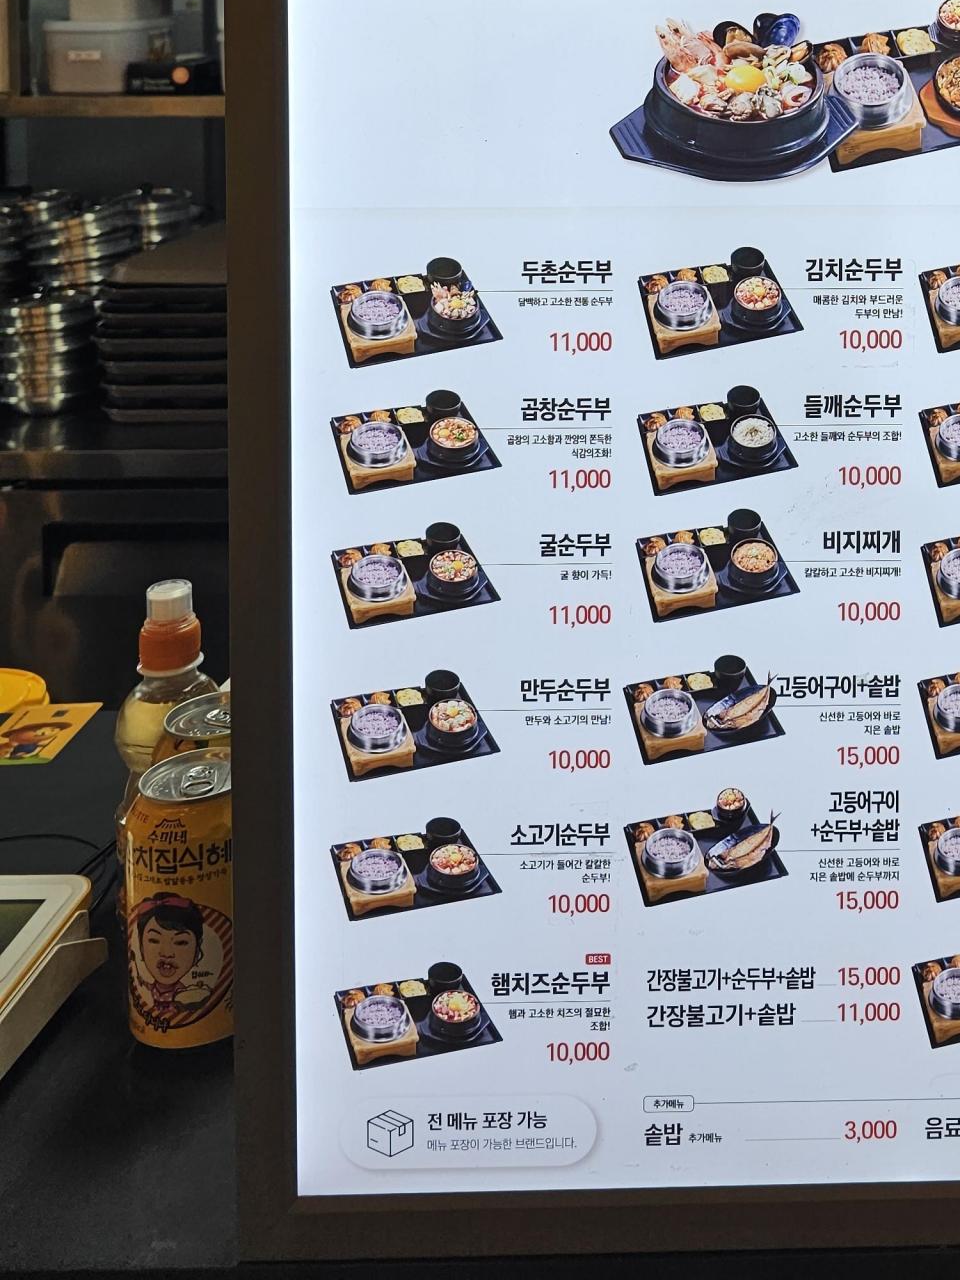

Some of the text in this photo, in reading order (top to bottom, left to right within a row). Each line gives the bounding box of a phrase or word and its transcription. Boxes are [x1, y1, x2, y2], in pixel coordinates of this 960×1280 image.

[521, 260, 613, 284] 두촌순두부
[805, 258, 903, 281] 김치순두부
[813, 295, 903, 305] 매콤한 김치와 부드러운
[855, 309, 903, 319] 두부의 만남!
[549, 332, 612, 355] 11,000
[839, 329, 903, 352] 10,000
[521, 398, 611, 421] 곱창순두부
[804, 394, 902, 418] 들깨순두부
[548, 469, 612, 492] 11,000
[838, 466, 902, 489] 10,000
[539, 533, 611, 557] 굴순두부
[823, 530, 901, 554] 비지찌개
[560, 570, 612, 580] 굴 향이 가득!
[549, 605, 611, 628] 11,000
[837, 601, 900, 625] 10,000
[521, 678, 611, 702] 만두순두부
[776, 675, 901, 699] 고등어구이+솥밥
[820, 712, 900, 722] 신선한 고등어와 바로
[864, 725, 900, 735] 지은 솥밥
[548, 750, 611, 773] 10,000
[836, 746, 900, 768] 15,000
[828, 790, 900, 814] 고등어구이
[510, 823, 610, 847] 소고기순두부
[810, 819, 900, 842] +순두부+솥밥
[133, 839, 232, 874] 치집식혜
[520, 860, 610, 870] 소고기가 들어간 칼칼한
[582, 873, 610, 883] 순두부!
[548, 894, 610, 916] 10,000
[836, 890, 899, 913] 15,000
[588, 955, 608, 963] BEST
[491, 972, 610, 996] 햄치즈순두부
[646, 966, 900, 992] 간장불고기+순두부+솥밥 15,000
[647, 1002, 900, 1027] 간장불고기+솥밥 11,000
[547, 1042, 610, 1065] 10,000
[653, 1099, 684, 1109] 추가메뉴
[428, 1112, 547, 1130] 전 메뉴 포장 가능
[644, 1119, 897, 1146] 솥밥 추가메뉴 3,000
[427, 1140, 447, 1150] 메뉴
[450, 1139, 480, 1150] 포장이
[483, 1139, 512, 1150] 가능한
